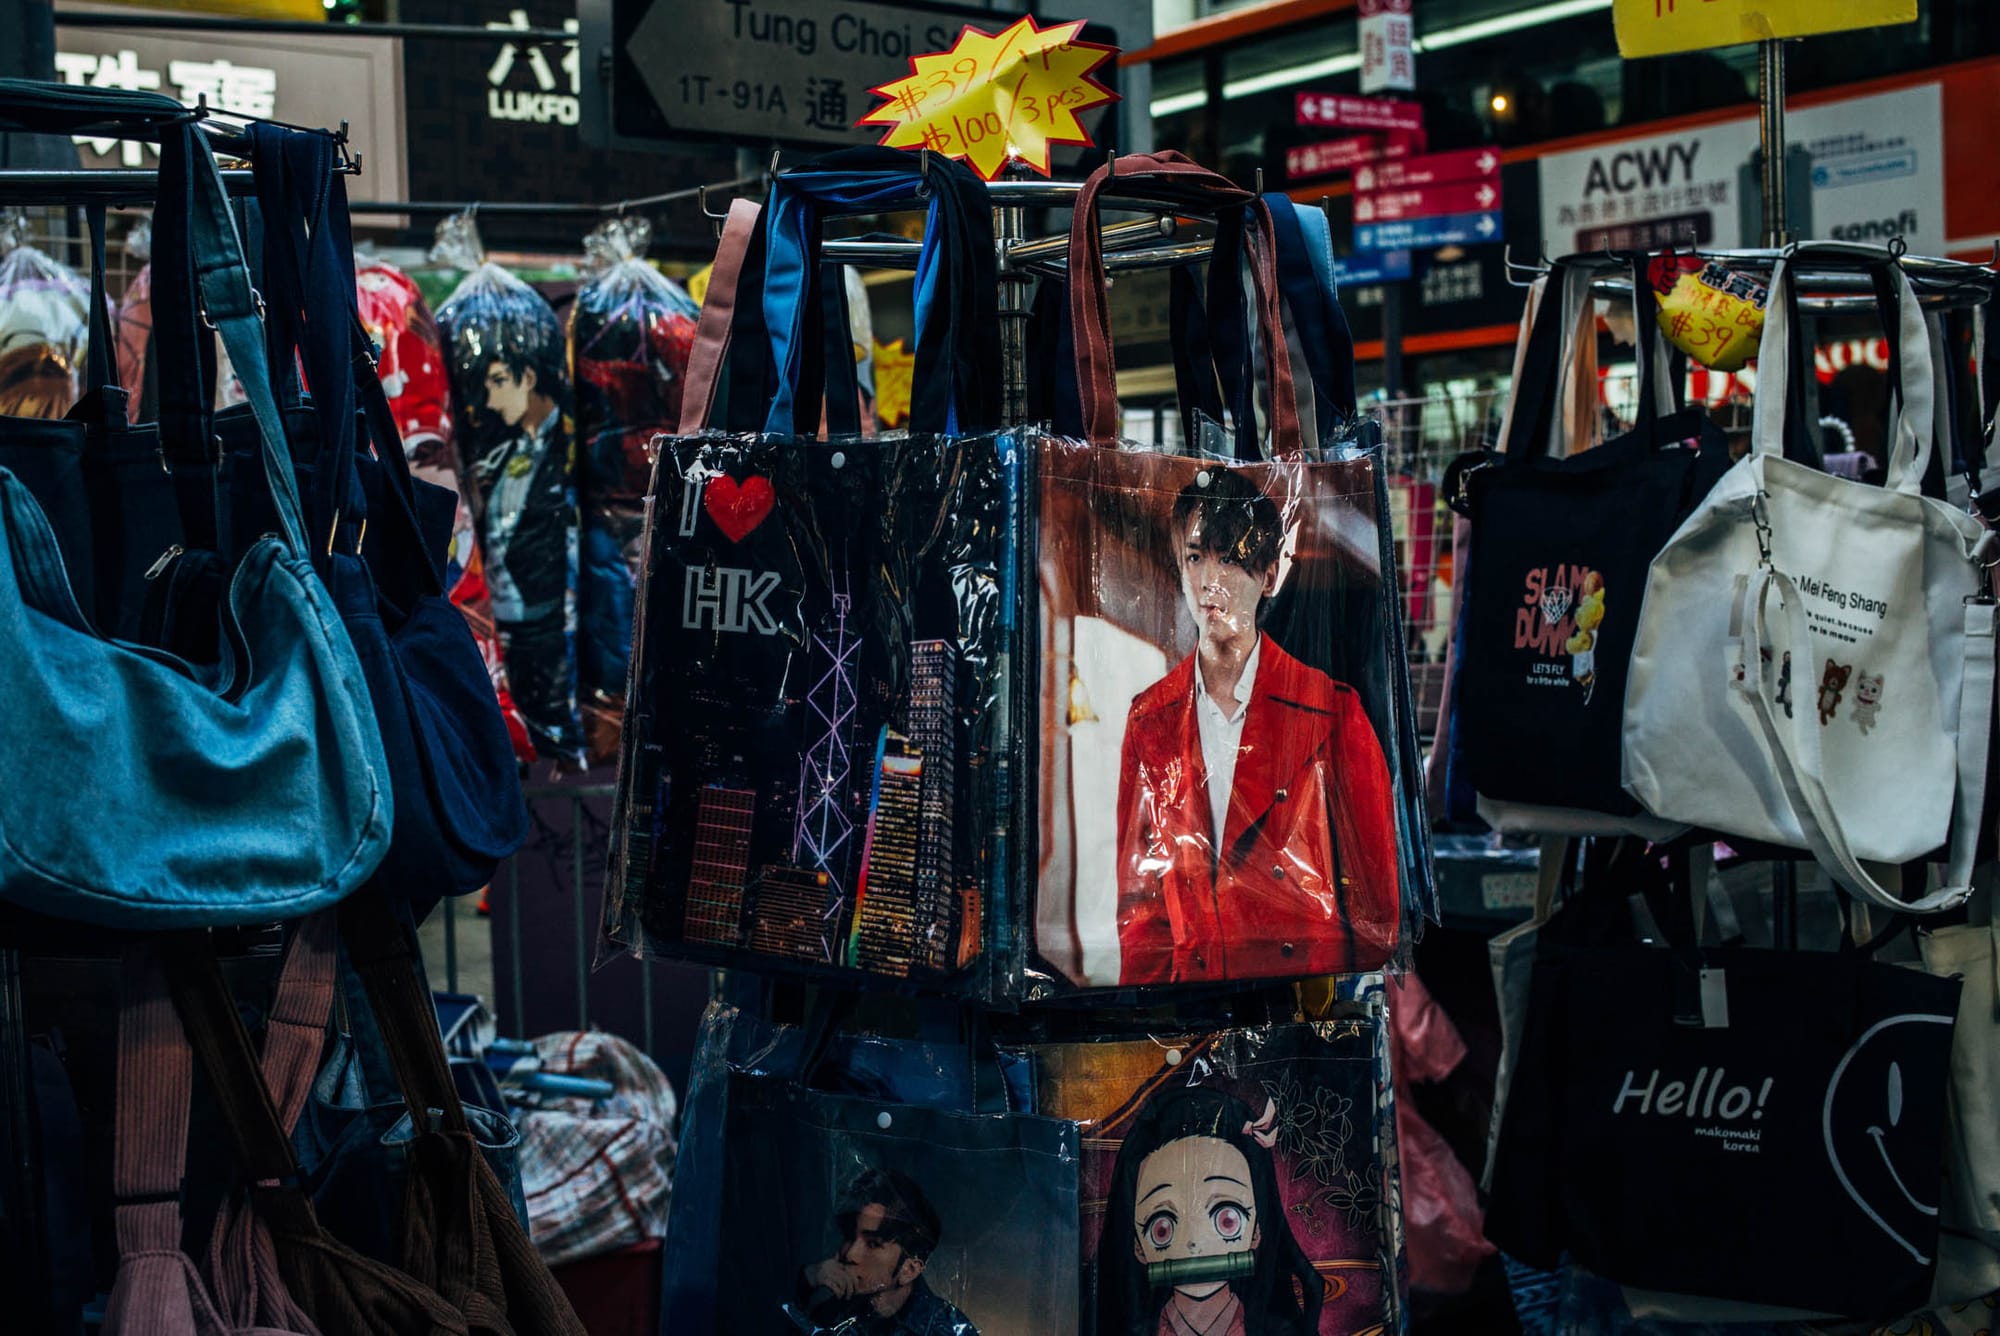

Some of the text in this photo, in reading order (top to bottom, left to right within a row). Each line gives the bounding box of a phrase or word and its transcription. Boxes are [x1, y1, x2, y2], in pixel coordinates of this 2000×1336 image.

[724, 0, 958, 58] Tung Choi S
[678, 75, 789, 115] 1T-91A
[1583, 138, 1702, 198] ACWY
[1831, 208, 1918, 242] sanofi
[1671, 310, 1734, 357] $39
[682, 565, 782, 636] HK
[1524, 563, 1589, 606] SLAM
[1800, 575, 1820, 595] Mei
[1821, 583, 1847, 609] Feng
[1849, 592, 1888, 619] Shang
[1829, 630, 1857, 644] meow
[1613, 1066, 1774, 1119] Hello!
[1694, 1126, 1761, 1140] makomaki
[1723, 1139, 1760, 1153] korea
